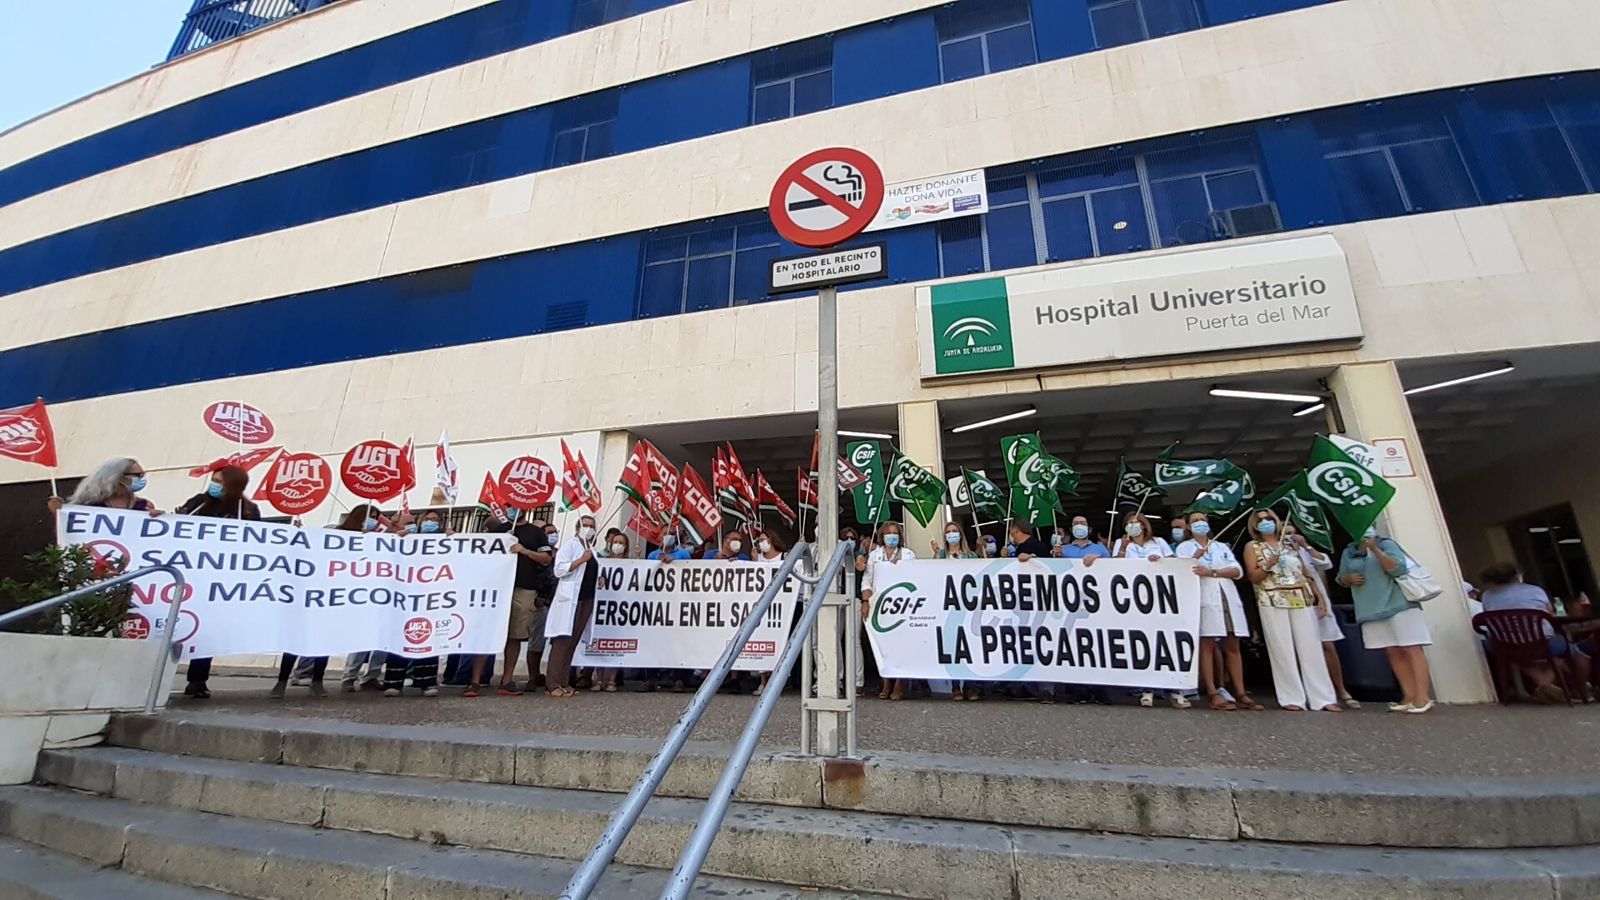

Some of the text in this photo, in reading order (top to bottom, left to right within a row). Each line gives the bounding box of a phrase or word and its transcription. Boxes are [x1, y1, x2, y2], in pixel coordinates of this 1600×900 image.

[888, 174, 977, 197] HAZTE DONANTE
[905, 188, 962, 203] DONA VIDA
[776, 250, 877, 273] EN TODO EL RECINTO
[791, 263, 861, 281] HOSPITALARIO
[1035, 275, 1327, 326] Hospital Universitario
[1185, 303, 1331, 333] Puerta del Mar
[944, 348, 961, 357] JUNTA
[963, 347, 971, 355] DE
[213, 402, 263, 427] UGT
[279, 458, 323, 483] UGT
[352, 444, 401, 472] UGT
[510, 458, 550, 486] UGT
[66, 511, 507, 556] EN DEFENSA DE NUESTRA
[139, 549, 455, 584] SANIDAD PÚBLICA
[627, 567, 640, 591] A
[643, 567, 676, 592] LOS
[680, 568, 765, 592] RECORTES
[132, 578, 498, 612] NO MÁS RECORTES !!!
[943, 574, 1180, 615] ACABEMOS CON
[594, 601, 674, 626] ERSONAL
[678, 601, 700, 626] EN
[706, 602, 725, 627] EL
[767, 602, 782, 628] !!!
[600, 640, 629, 649] CCOO
[743, 643, 767, 651] COO
[935, 625, 1195, 673] LA PRECARIEDAD
